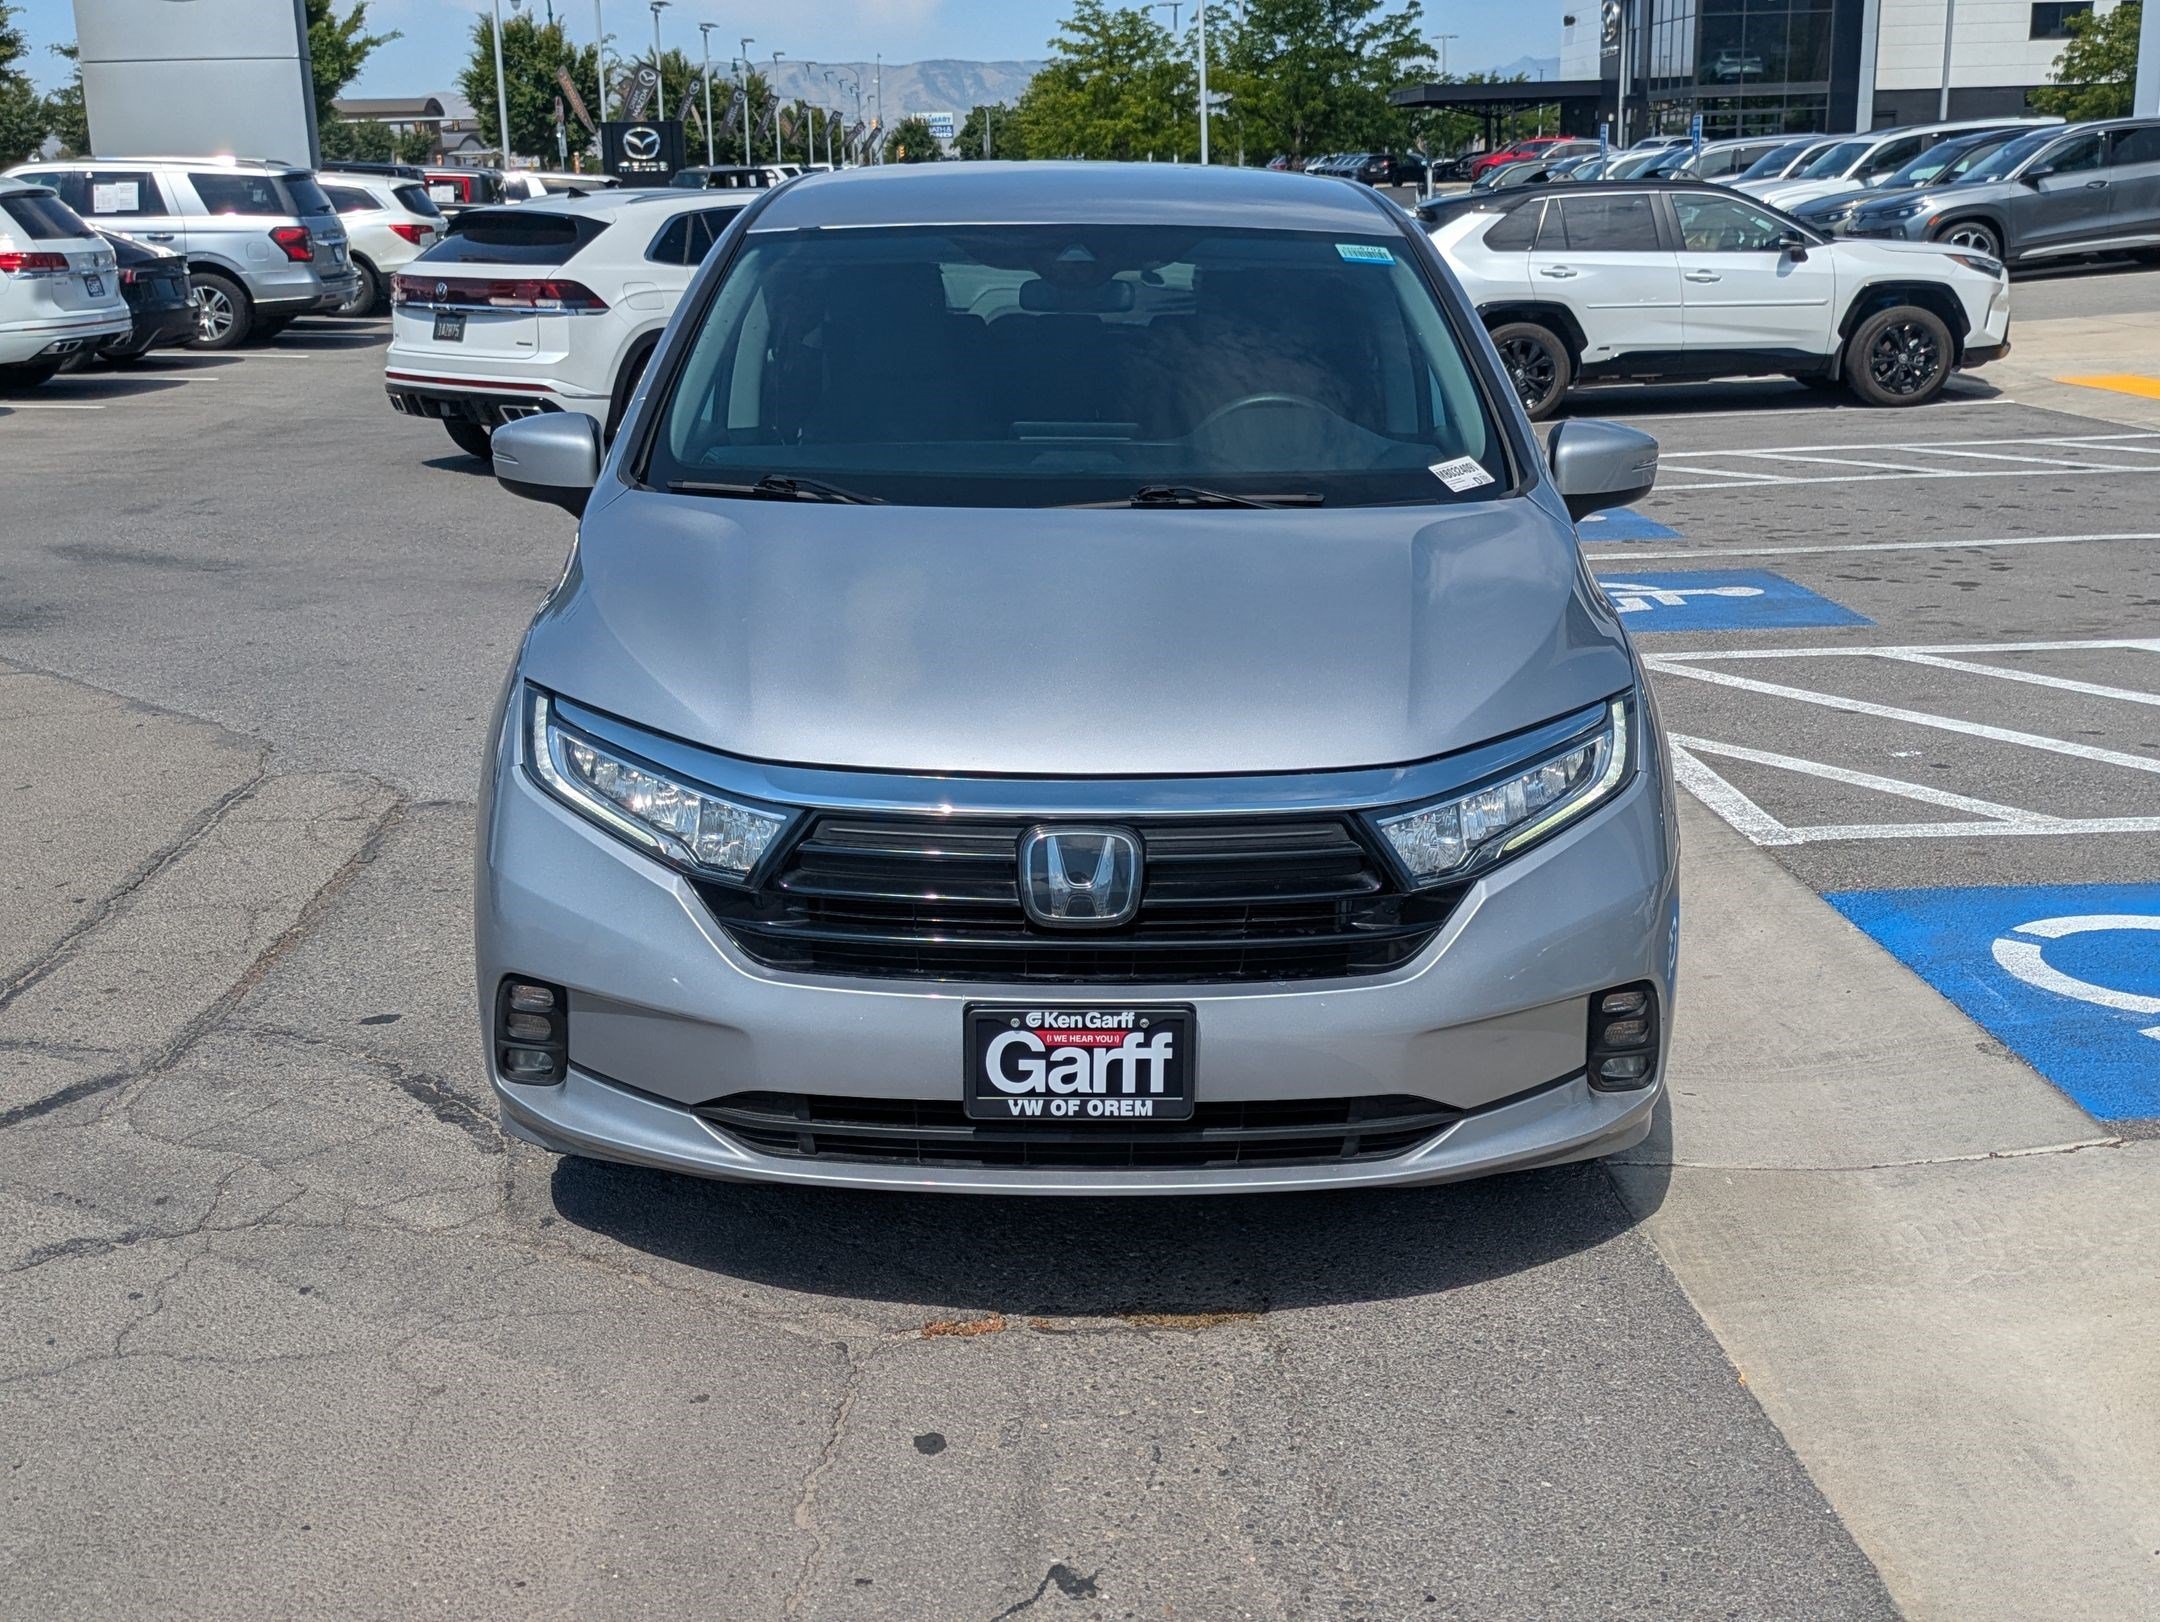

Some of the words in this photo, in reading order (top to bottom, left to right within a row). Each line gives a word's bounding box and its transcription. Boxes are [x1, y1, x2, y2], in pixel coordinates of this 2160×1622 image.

[1044, 1012, 1082, 1028] Ken
[1085, 1012, 1135, 1028] Garff
[1053, 1035, 1067, 1043] WE
[1069, 1035, 1093, 1043] HEAR
[1095, 1035, 1113, 1043] YOU
[985, 1031, 1173, 1094] Garff
[1008, 1100, 1043, 1116] VW
[1050, 1100, 1079, 1116] OF
[1087, 1100, 1153, 1116] OREM
